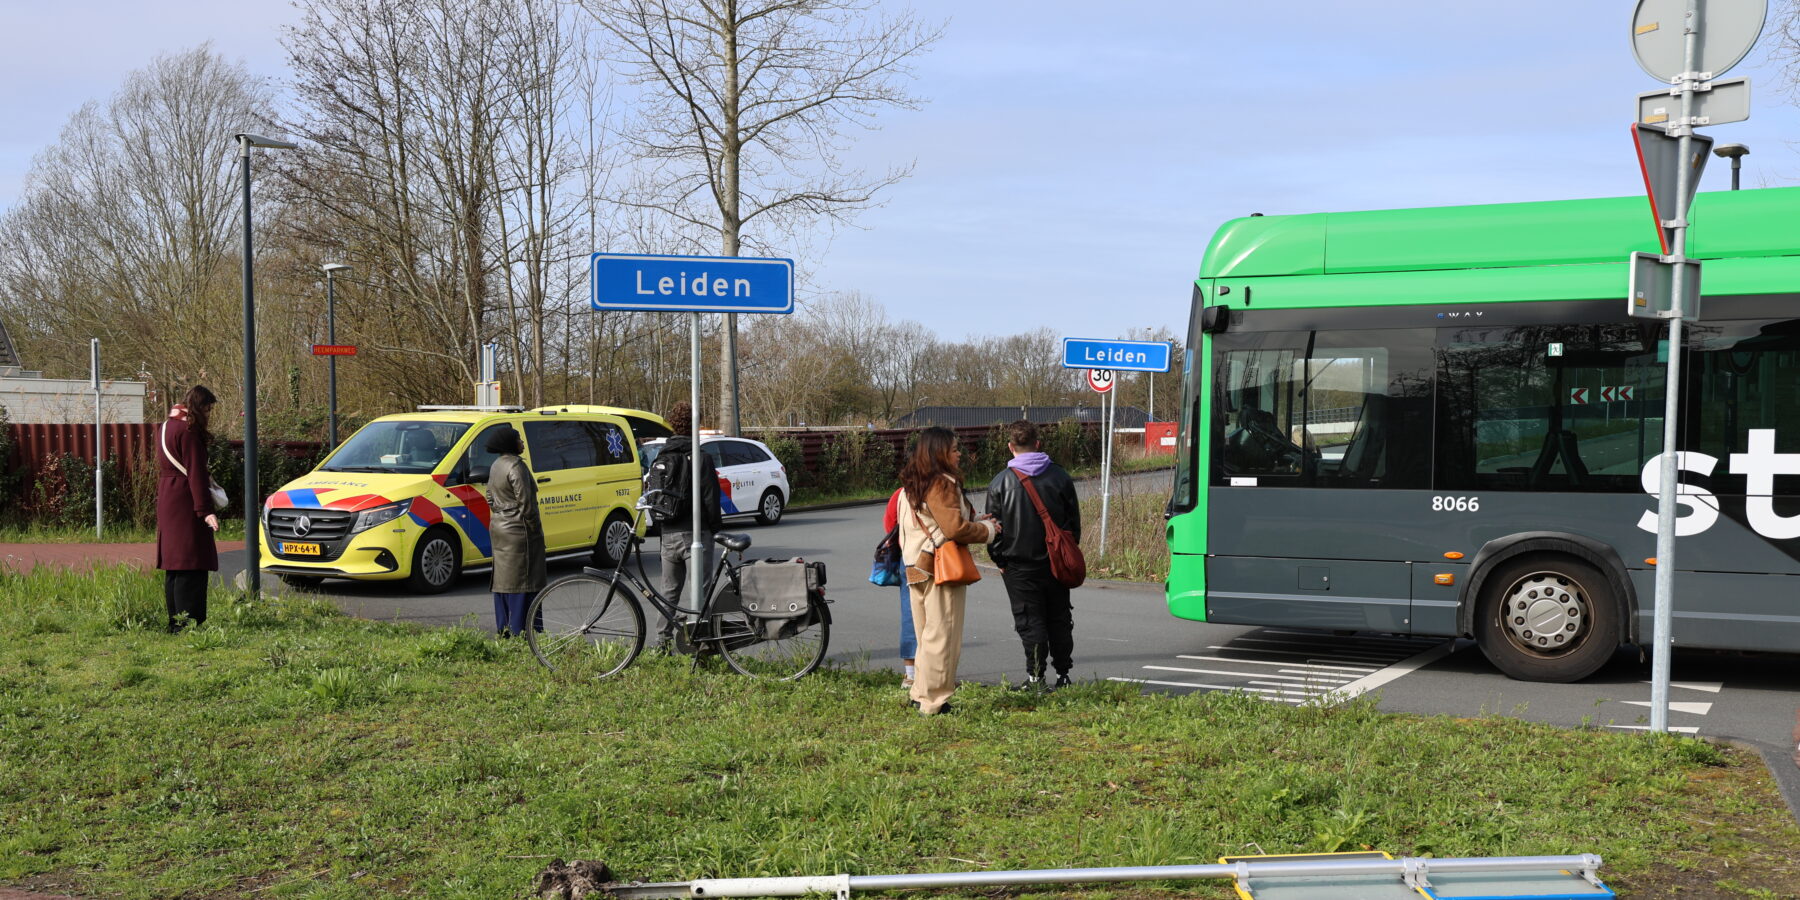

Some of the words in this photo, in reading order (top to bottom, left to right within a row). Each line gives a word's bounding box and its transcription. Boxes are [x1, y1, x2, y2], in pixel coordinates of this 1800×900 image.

[636, 270, 751, 297] Leiden
[1085, 346, 1147, 363] Leiden
[1093, 369, 1112, 382] 30
[540, 494, 582, 504] AMBULANCE
[615, 488, 630, 497] 16372
[1432, 496, 1479, 512] 8066
[284, 544, 318, 554] HPX-64-K
